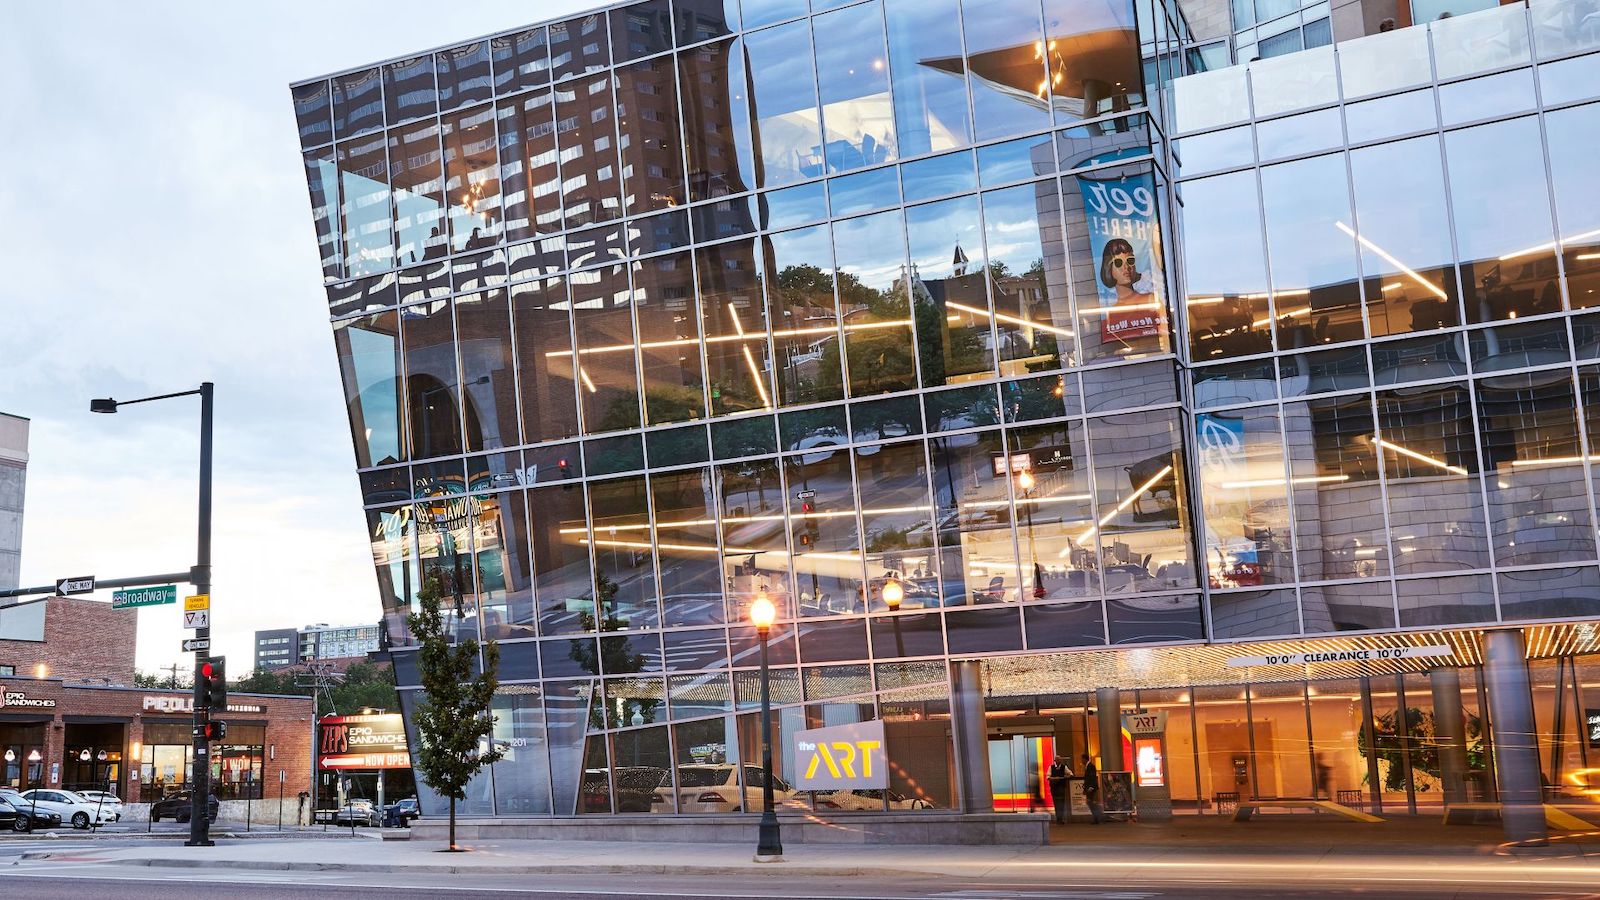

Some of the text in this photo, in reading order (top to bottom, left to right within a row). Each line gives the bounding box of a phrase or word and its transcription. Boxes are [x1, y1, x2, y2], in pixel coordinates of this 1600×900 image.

[66, 581, 91, 591] ONE WAY
[122, 589, 168, 604] Broadway
[1303, 650, 1370, 663] CLEARANCE
[5, 699, 56, 707] SANDWICHES
[227, 705, 260, 713] PIZZERIA
[1136, 716, 1157, 727] ART
[321, 725, 348, 753] ZEPS
[349, 734, 406, 744] SANDWICHE
[365, 752, 410, 767] NOW OPEN
[798, 740, 881, 780] the ART
